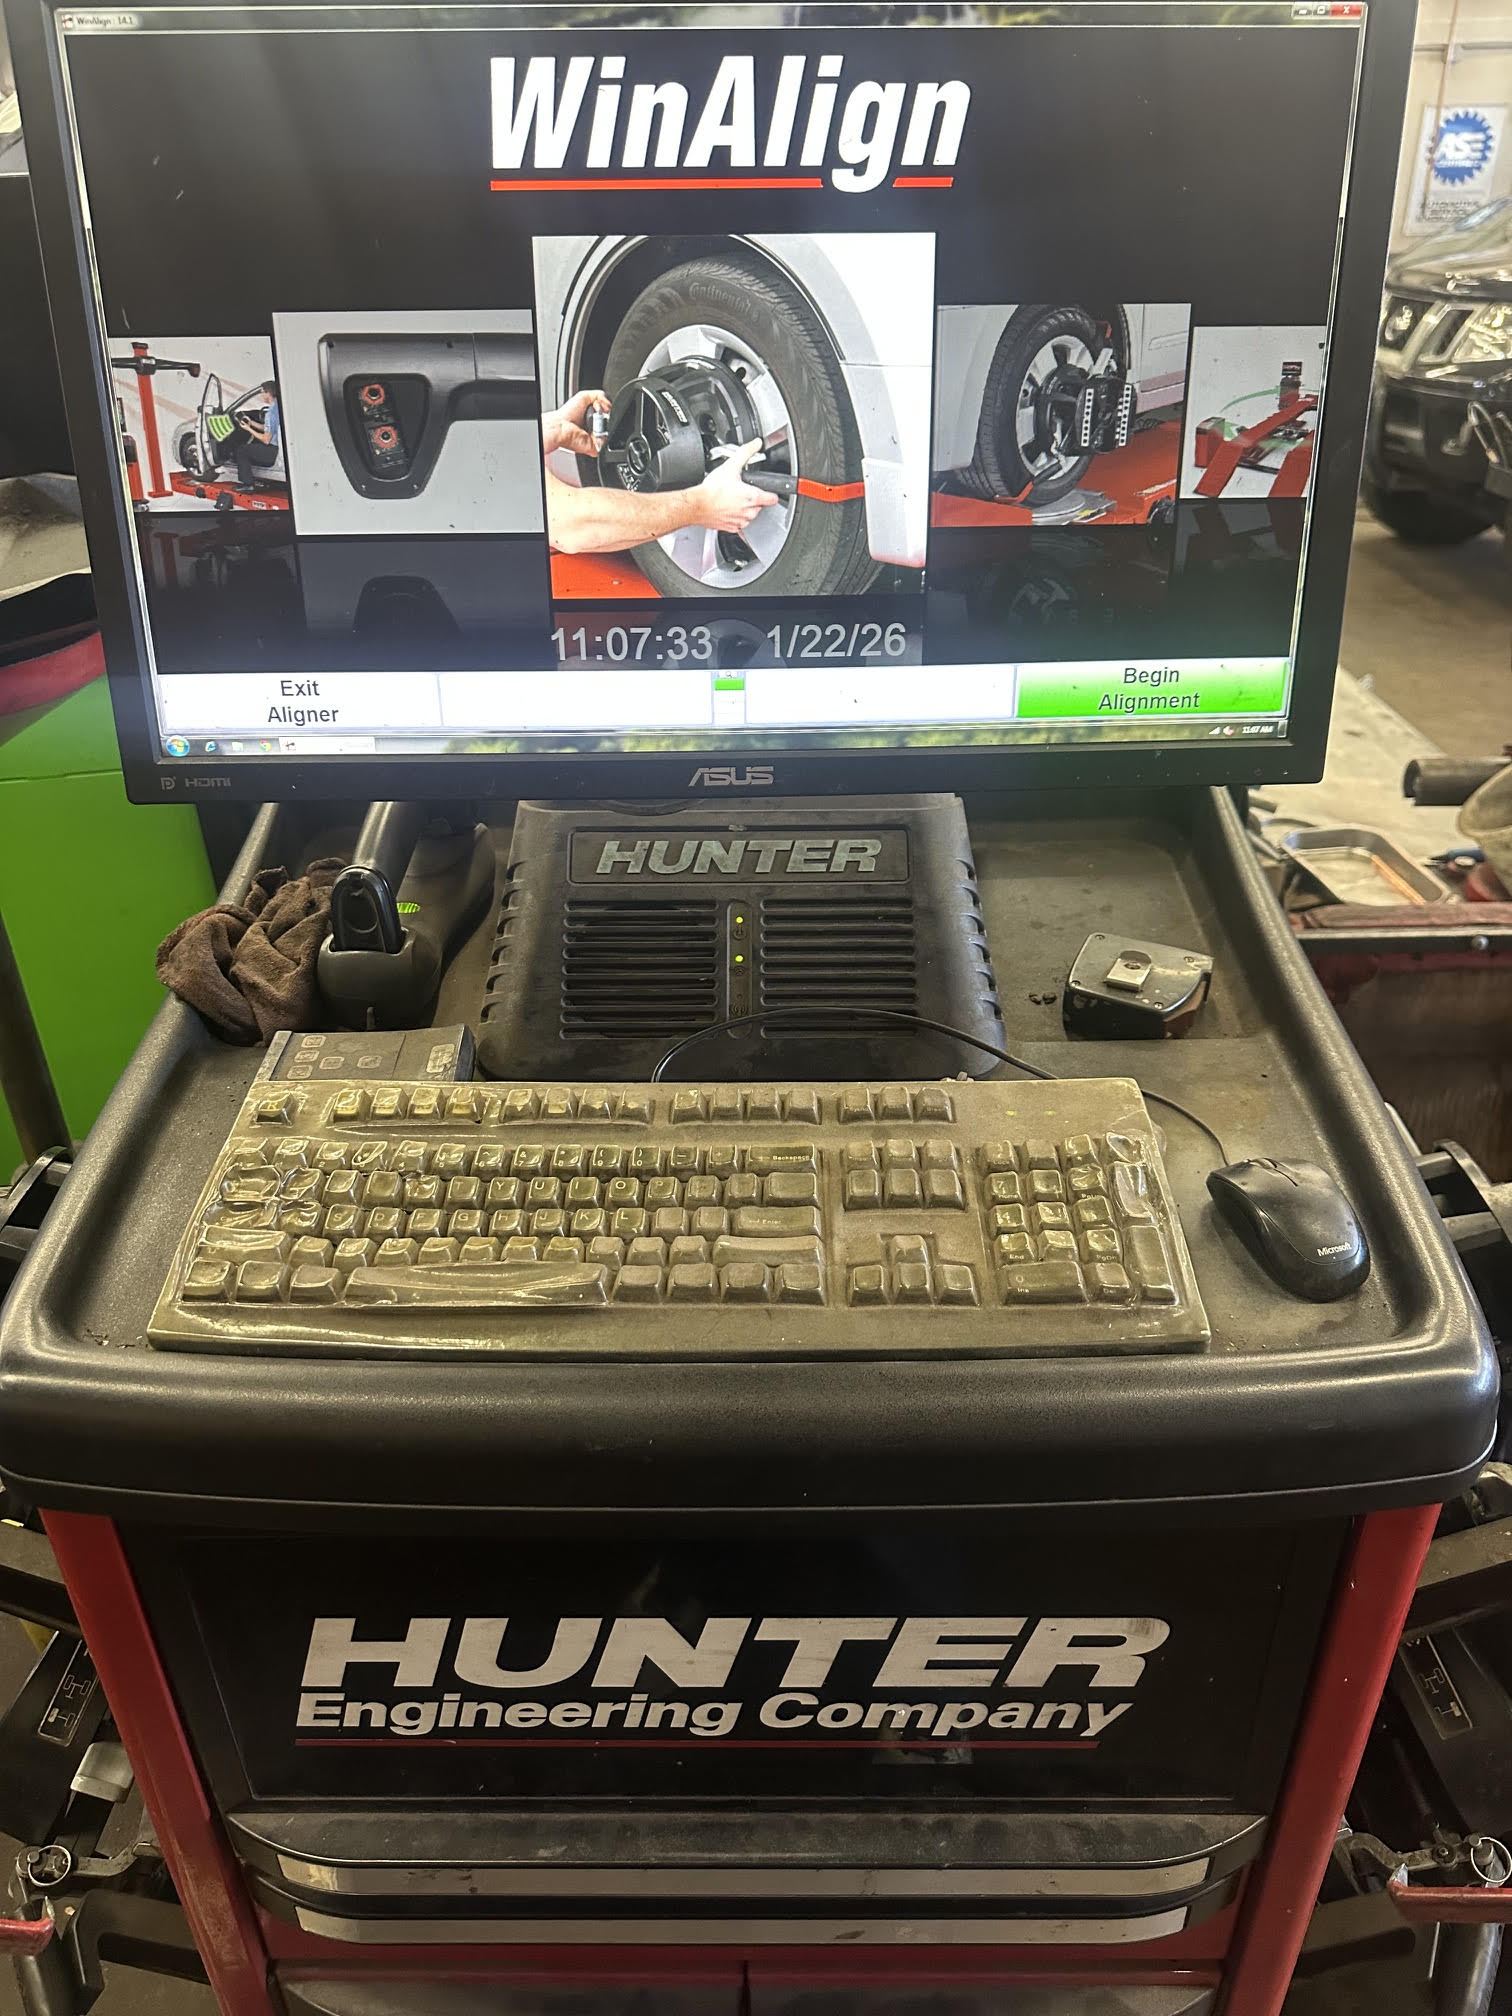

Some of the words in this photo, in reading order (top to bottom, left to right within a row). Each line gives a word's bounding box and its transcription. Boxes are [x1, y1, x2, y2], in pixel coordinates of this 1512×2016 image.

[77, 16, 112, 26] WinAlign
[118, 15, 133, 25] 14.1
[490, 55, 971, 193] WinAlign
[551, 626, 713, 661] 11:07:33
[766, 622, 907, 659] 1/22/26
[1123, 667, 1180, 687] Begin
[280, 679, 320, 698] Exit
[1098, 692, 1200, 714] Alignment
[268, 706, 339, 727] Aligner
[184, 777, 232, 788] HDMI
[688, 766, 774, 787] ASUS
[595, 839, 882, 875] HUNTER
[1317, 1242, 1352, 1256] Microsoft
[301, 1617, 1171, 1689] HUNTER
[296, 1692, 743, 1737] Engineering
[758, 1692, 1133, 1738] Company
